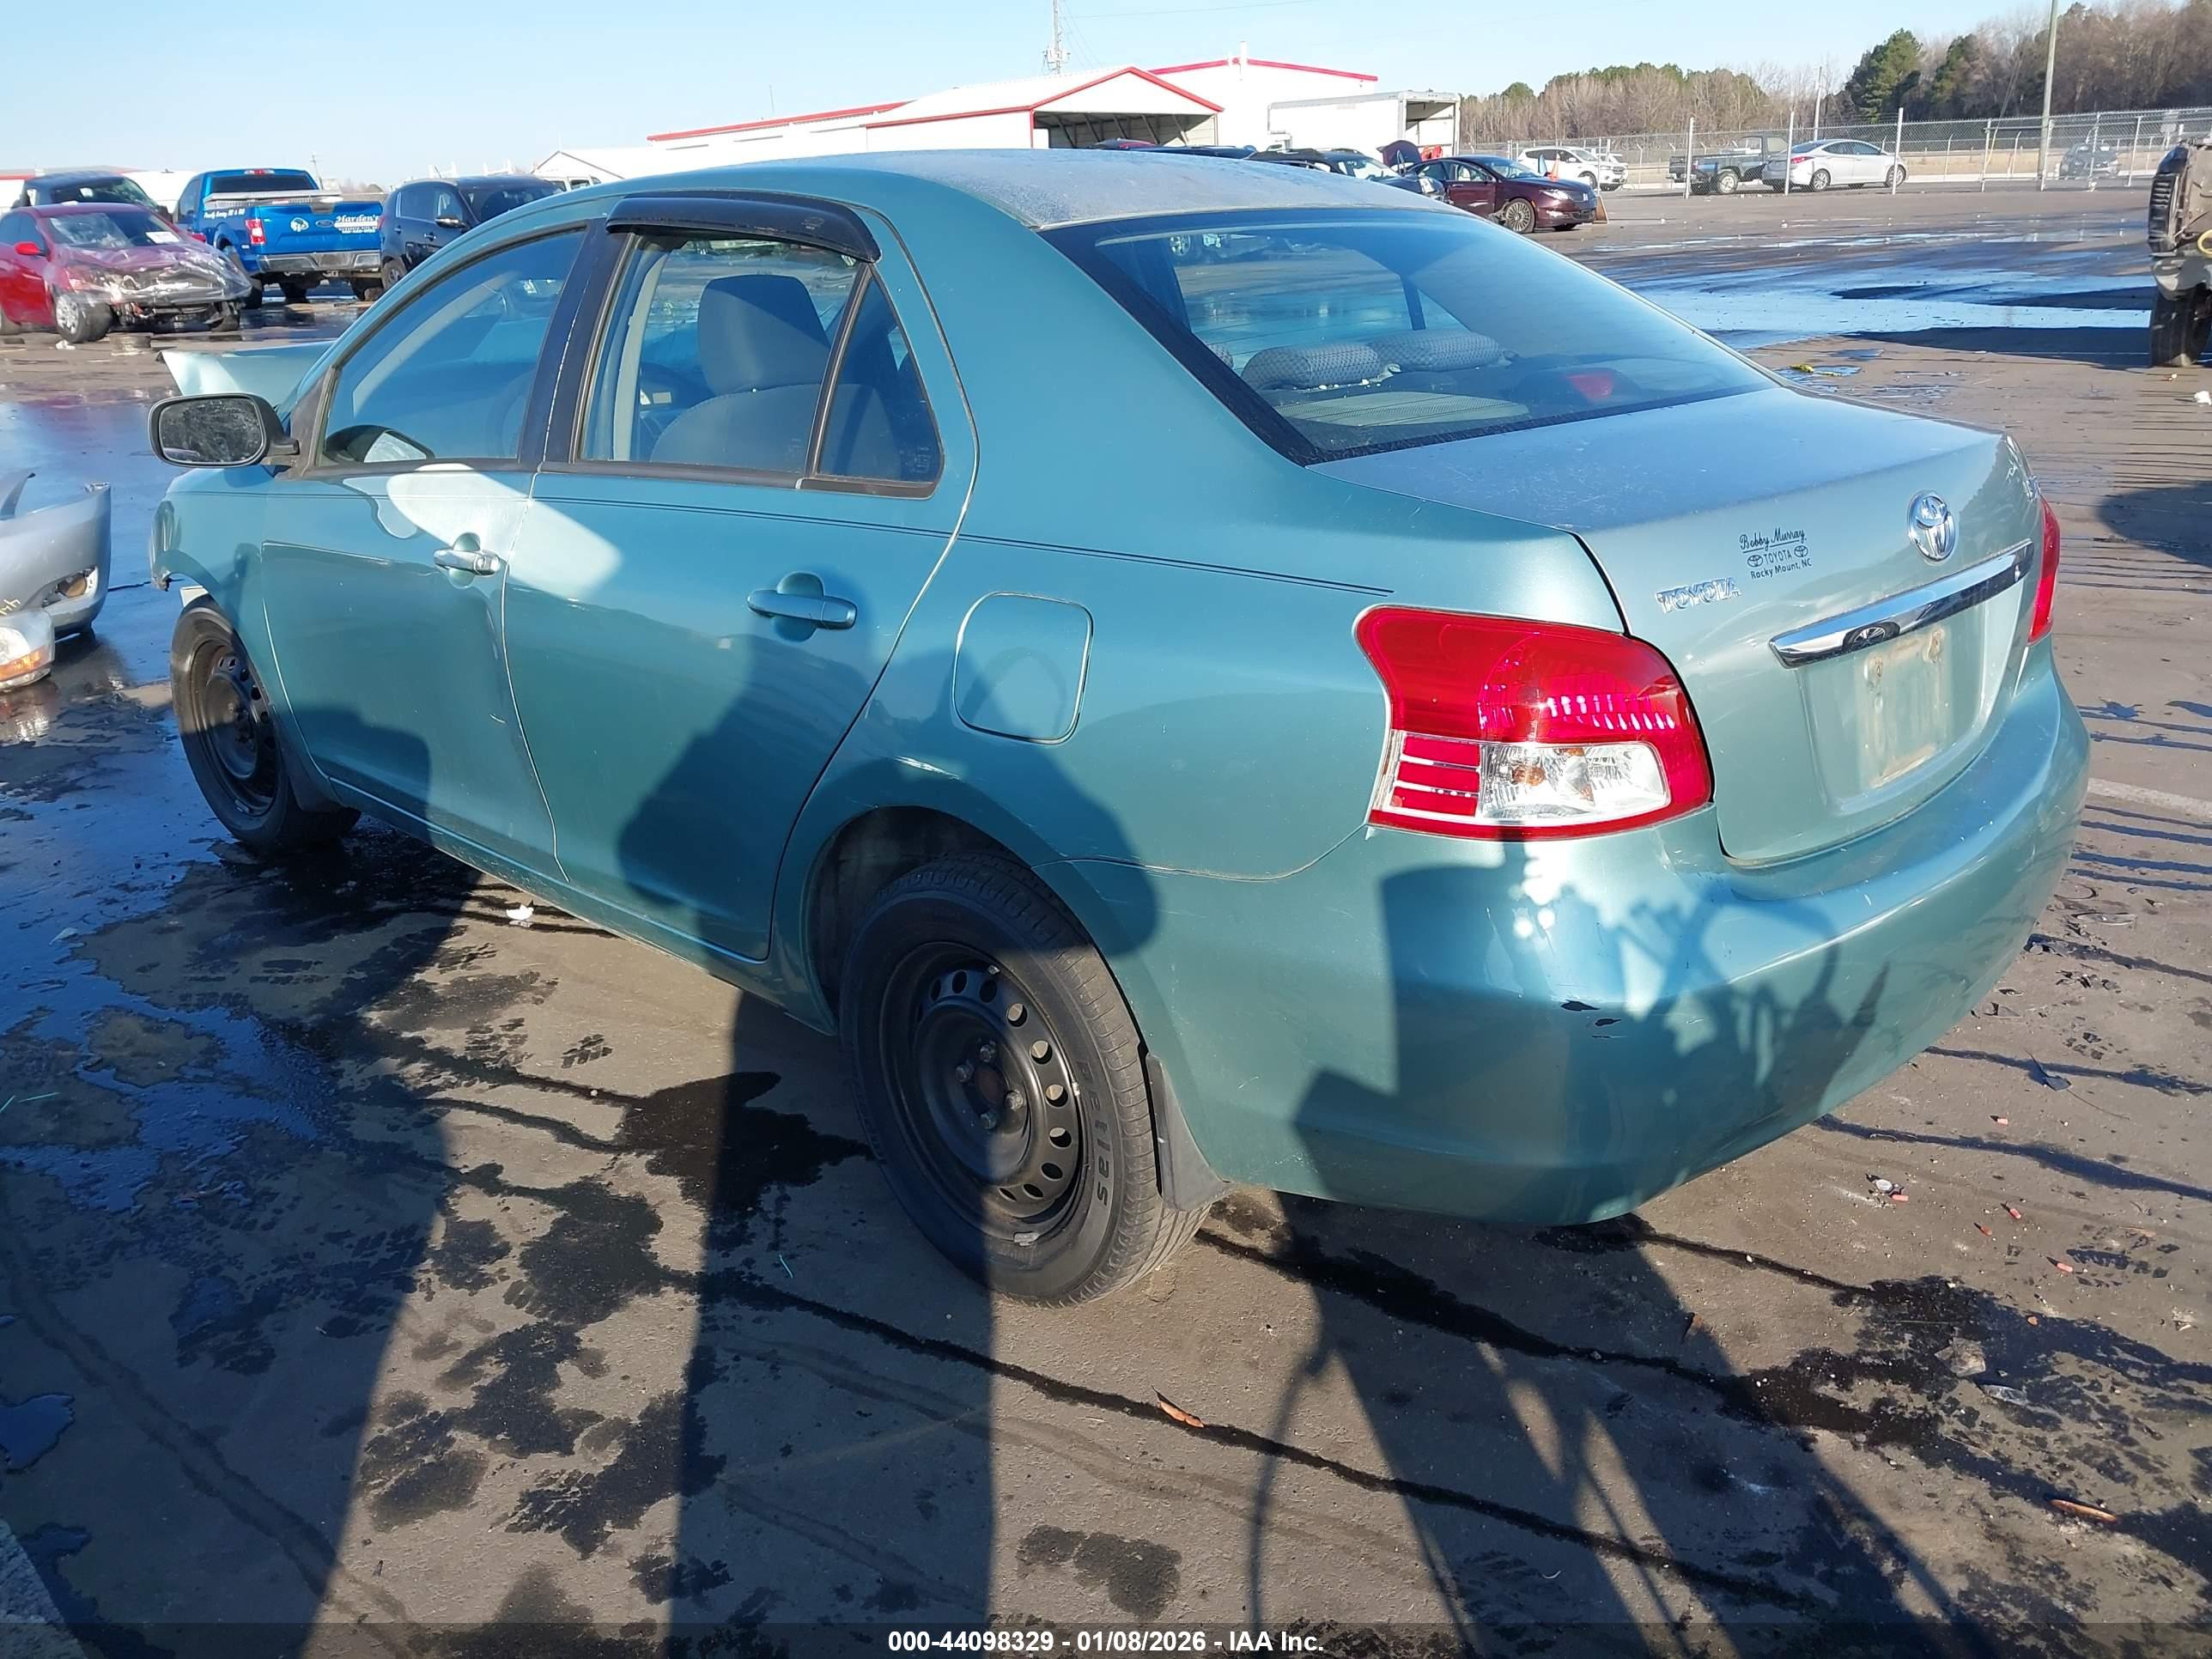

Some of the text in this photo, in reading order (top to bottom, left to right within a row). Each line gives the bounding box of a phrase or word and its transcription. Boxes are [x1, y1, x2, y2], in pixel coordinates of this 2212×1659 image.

[1739, 532, 1769, 551] Bobby
[1764, 550, 1792, 564] TOYOTA
[1751, 568, 1773, 580] Rocky
[1802, 558, 1812, 568] NC
[1656, 577, 1741, 613] TOYOTA
